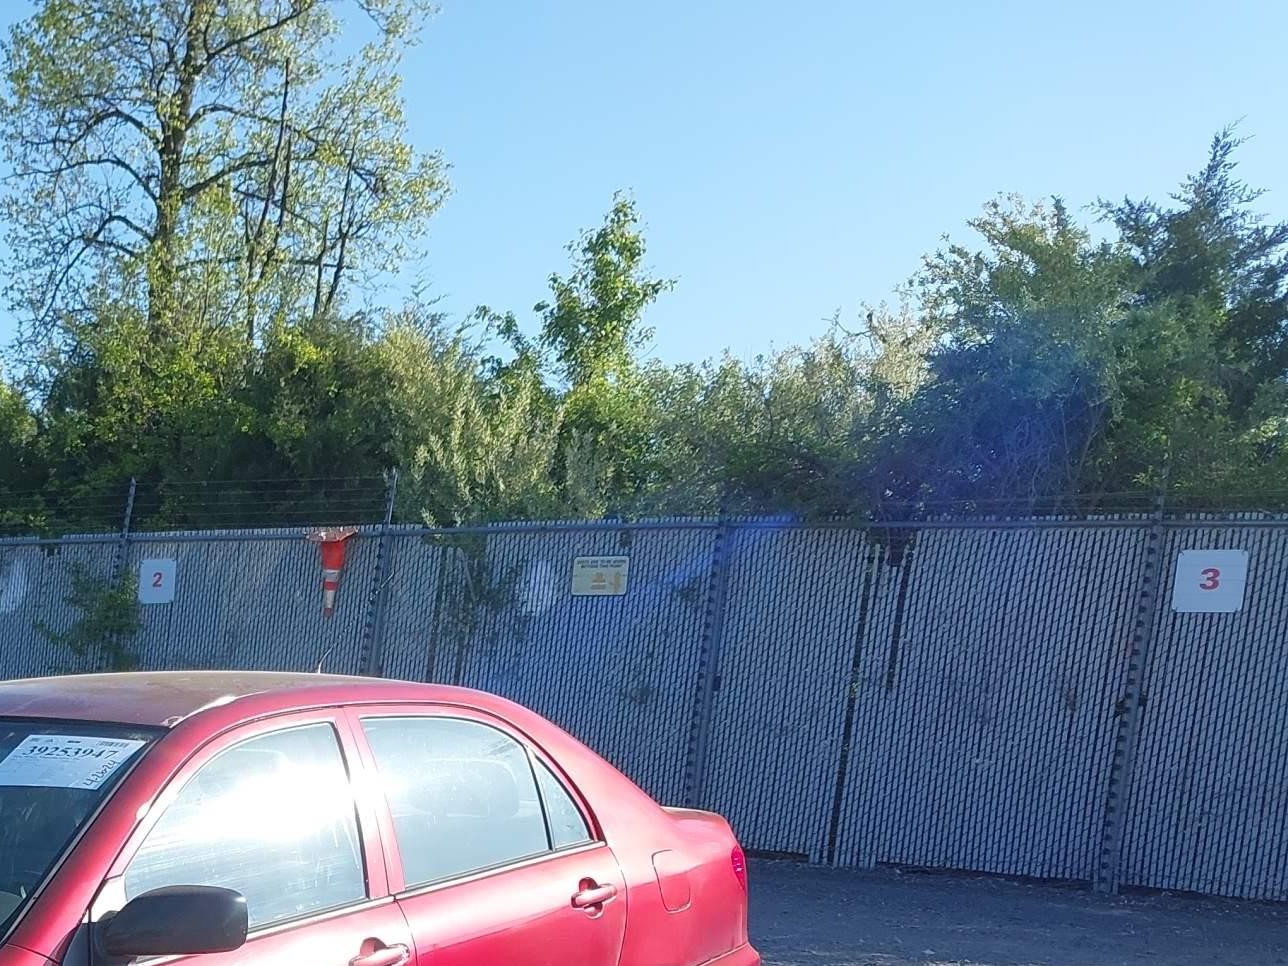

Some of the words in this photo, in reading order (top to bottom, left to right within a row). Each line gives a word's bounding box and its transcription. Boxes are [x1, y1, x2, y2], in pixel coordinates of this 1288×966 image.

[152, 571, 162, 588] 2
[1199, 568, 1220, 591] 3
[22, 745, 120, 760] 39253947
